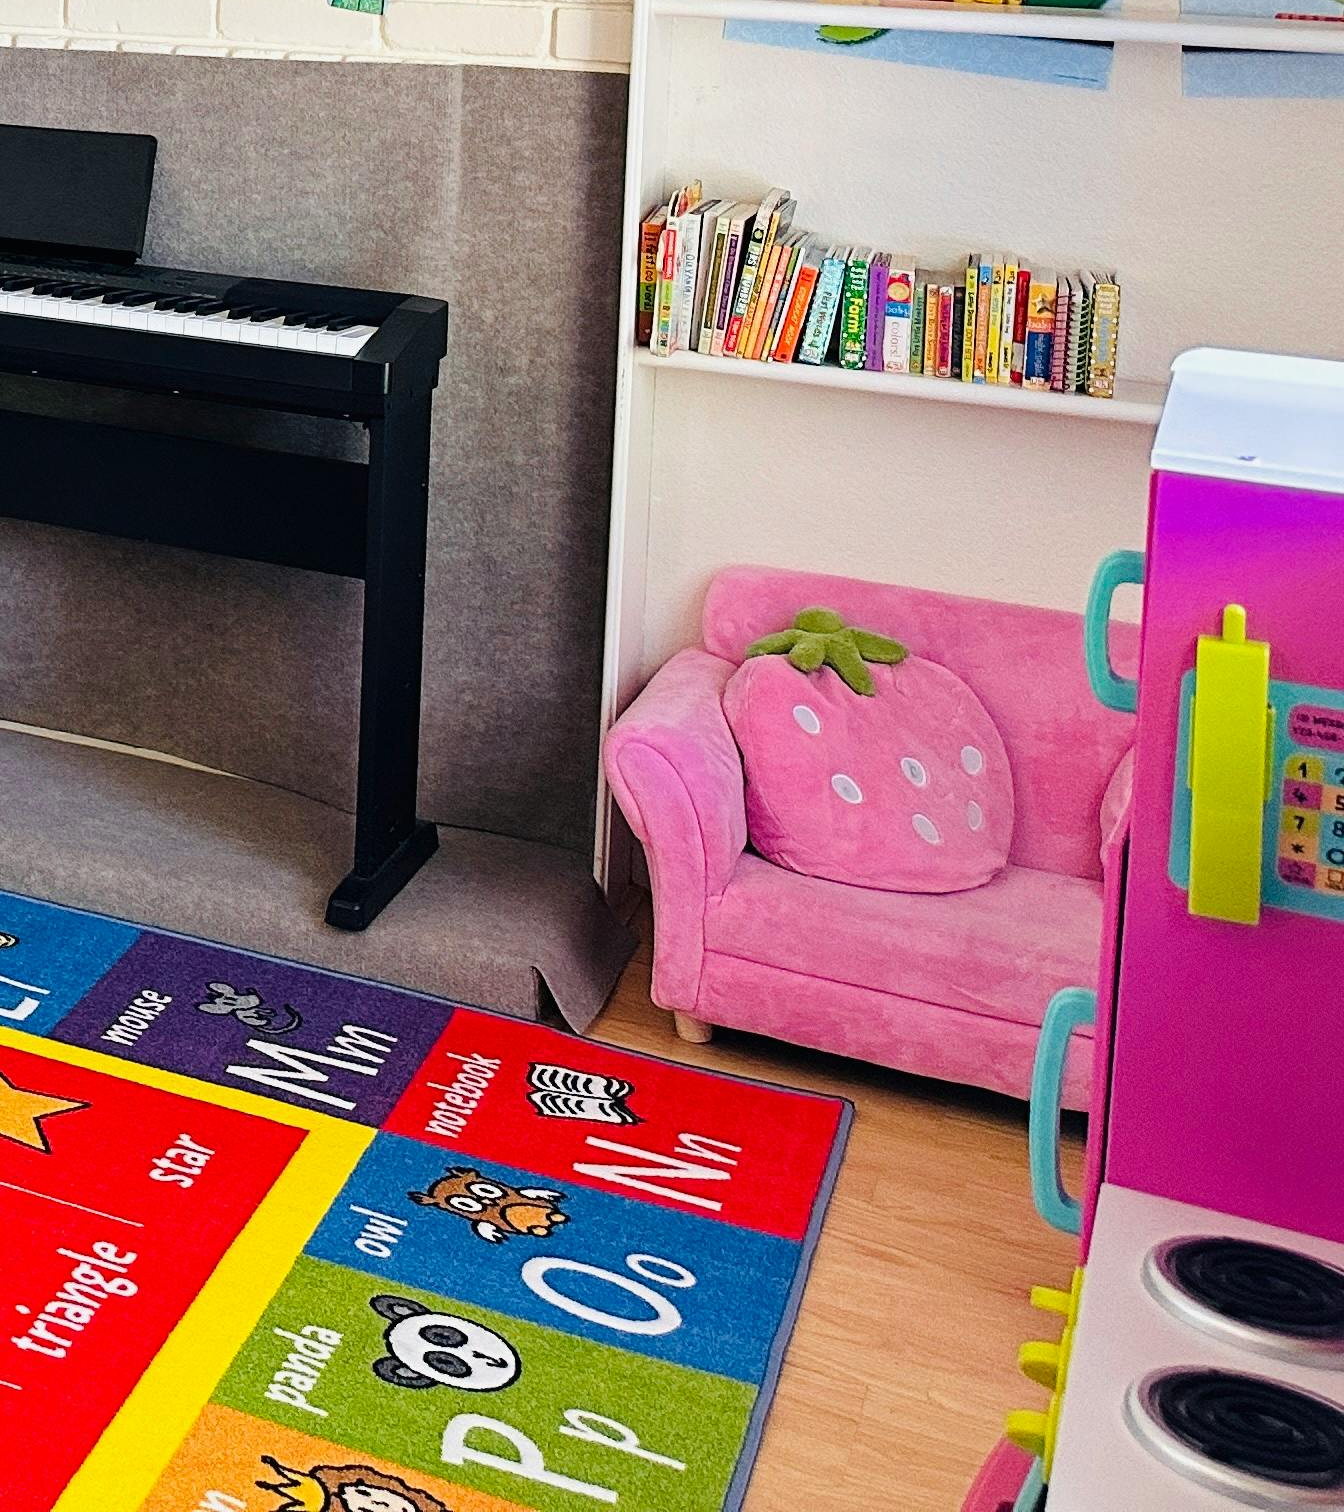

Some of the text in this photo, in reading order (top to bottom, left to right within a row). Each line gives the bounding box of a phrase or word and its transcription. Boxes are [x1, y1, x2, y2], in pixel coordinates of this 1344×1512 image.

[847, 298, 863, 333] Farm
[100, 986, 173, 1048] mouse
[423, 1050, 503, 1140] notebook
[147, 1131, 216, 1189] star
[352, 1201, 406, 1260] owl
[10, 1234, 139, 1362] triangle
[263, 1321, 342, 1416] panda
